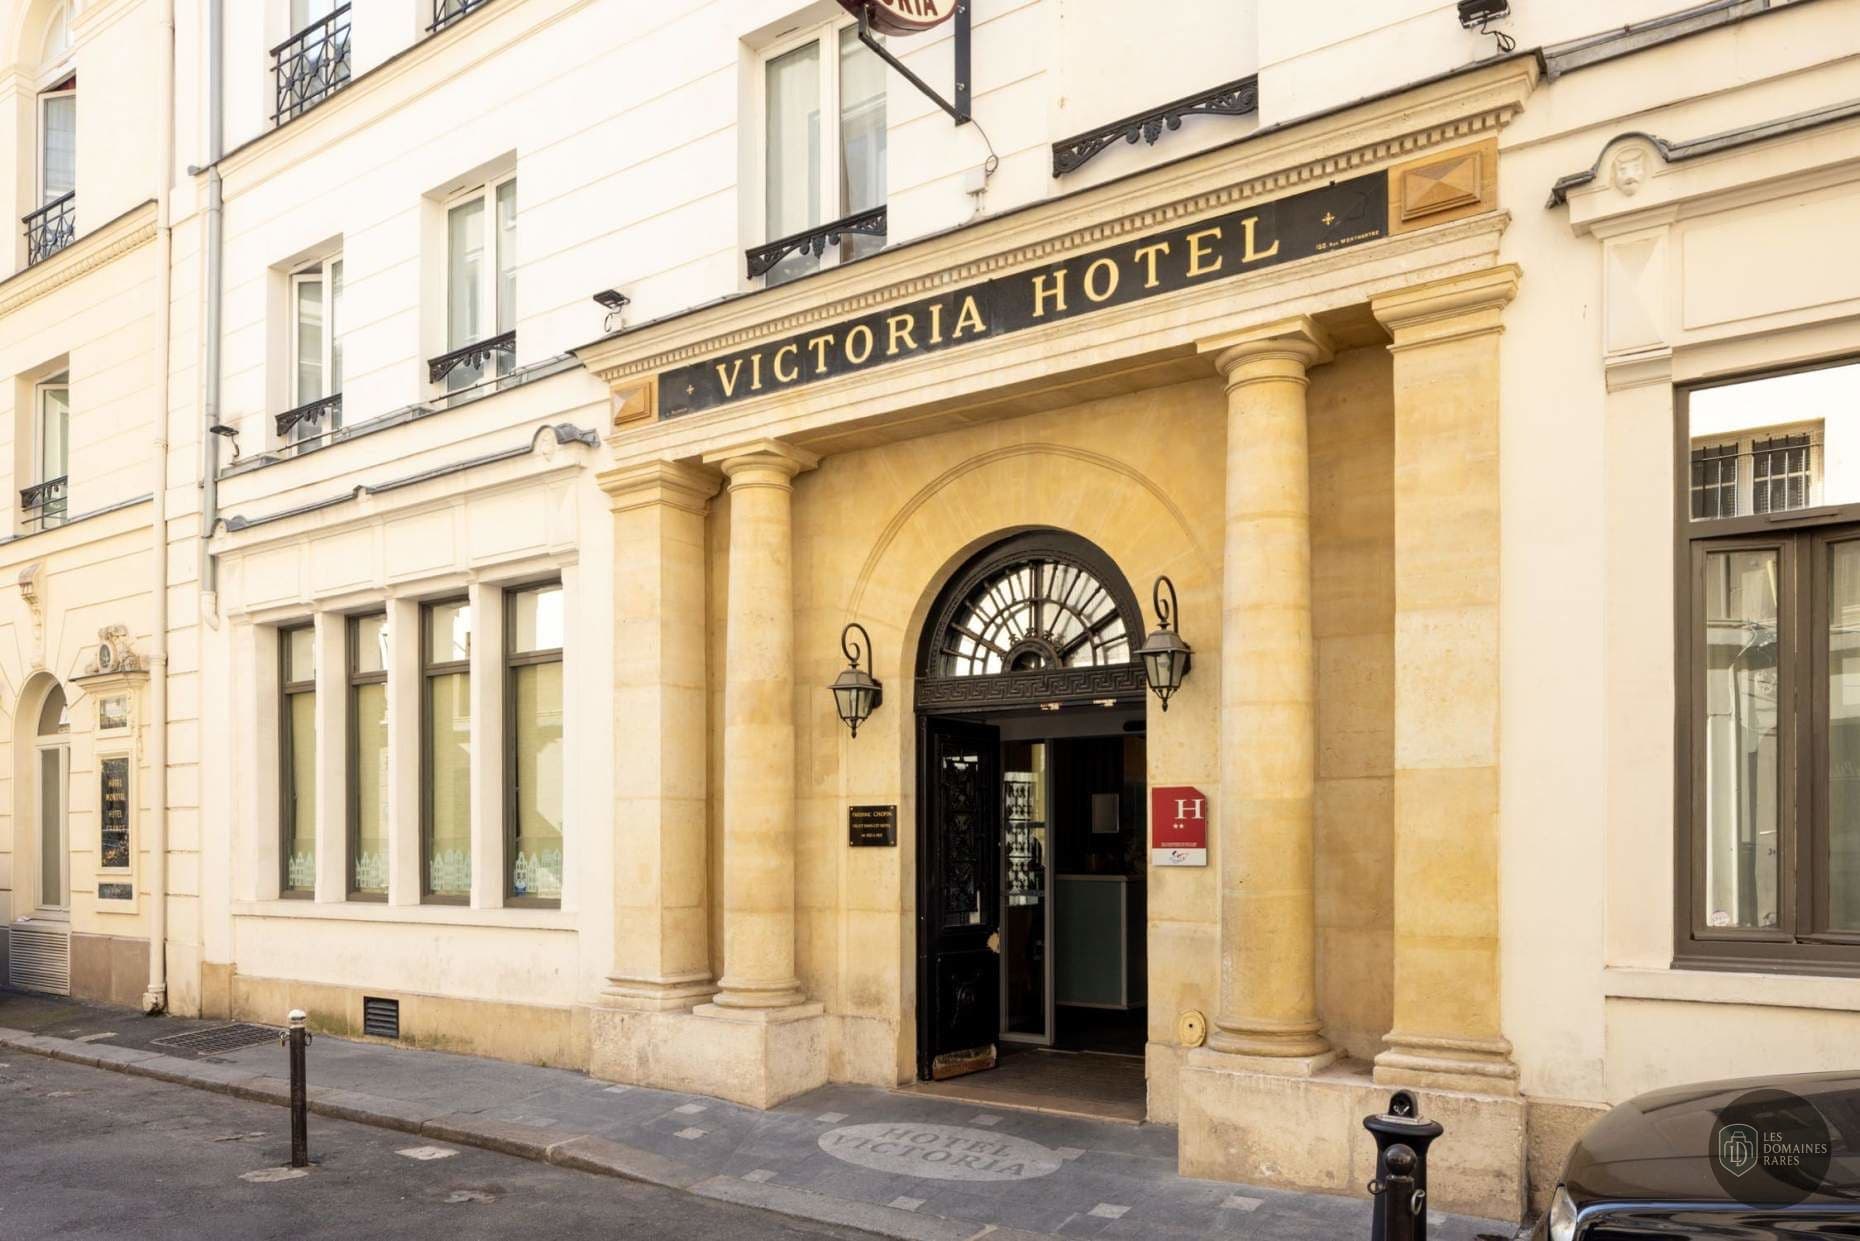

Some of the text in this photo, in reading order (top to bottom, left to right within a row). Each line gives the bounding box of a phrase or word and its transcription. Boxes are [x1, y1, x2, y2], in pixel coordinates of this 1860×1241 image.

[716, 216, 1280, 397] VICTORIA HOTEL
[1174, 798, 1204, 820] H
[832, 1135, 1025, 1176] VICTORIA
[879, 1128, 1012, 1157] HOTEL
